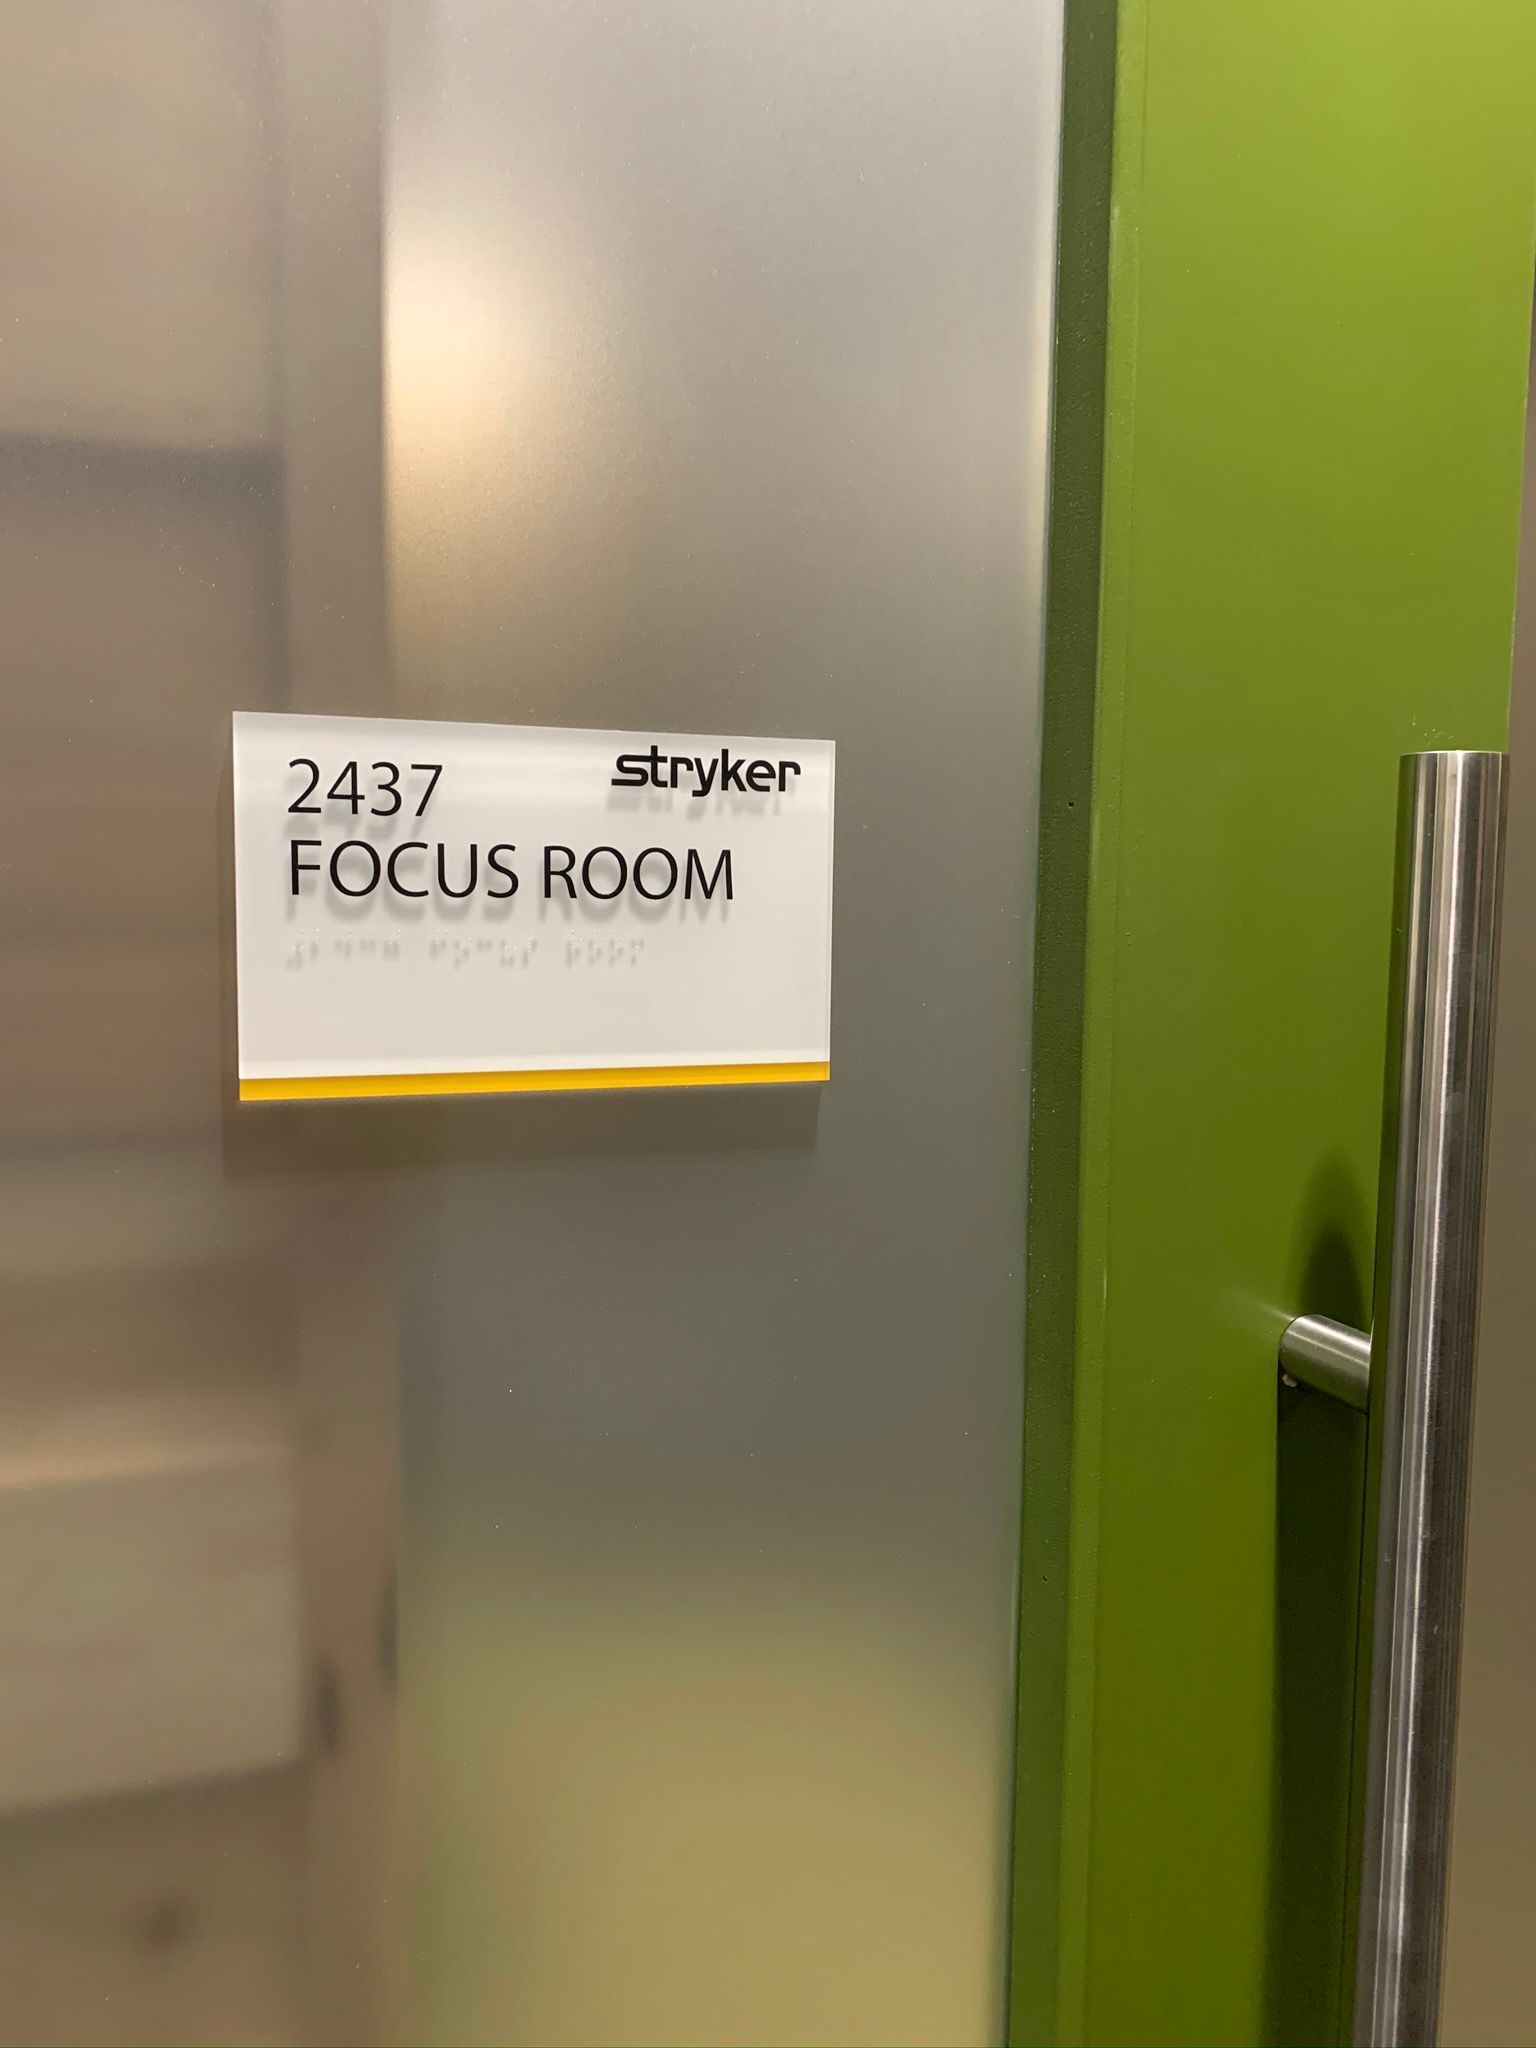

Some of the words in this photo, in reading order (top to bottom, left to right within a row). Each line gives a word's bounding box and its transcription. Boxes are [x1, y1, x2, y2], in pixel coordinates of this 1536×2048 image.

[287, 758, 443, 817] 2437
[611, 744, 802, 798] stryker
[290, 839, 519, 899] FOCUS
[543, 845, 734, 900] ROOM
